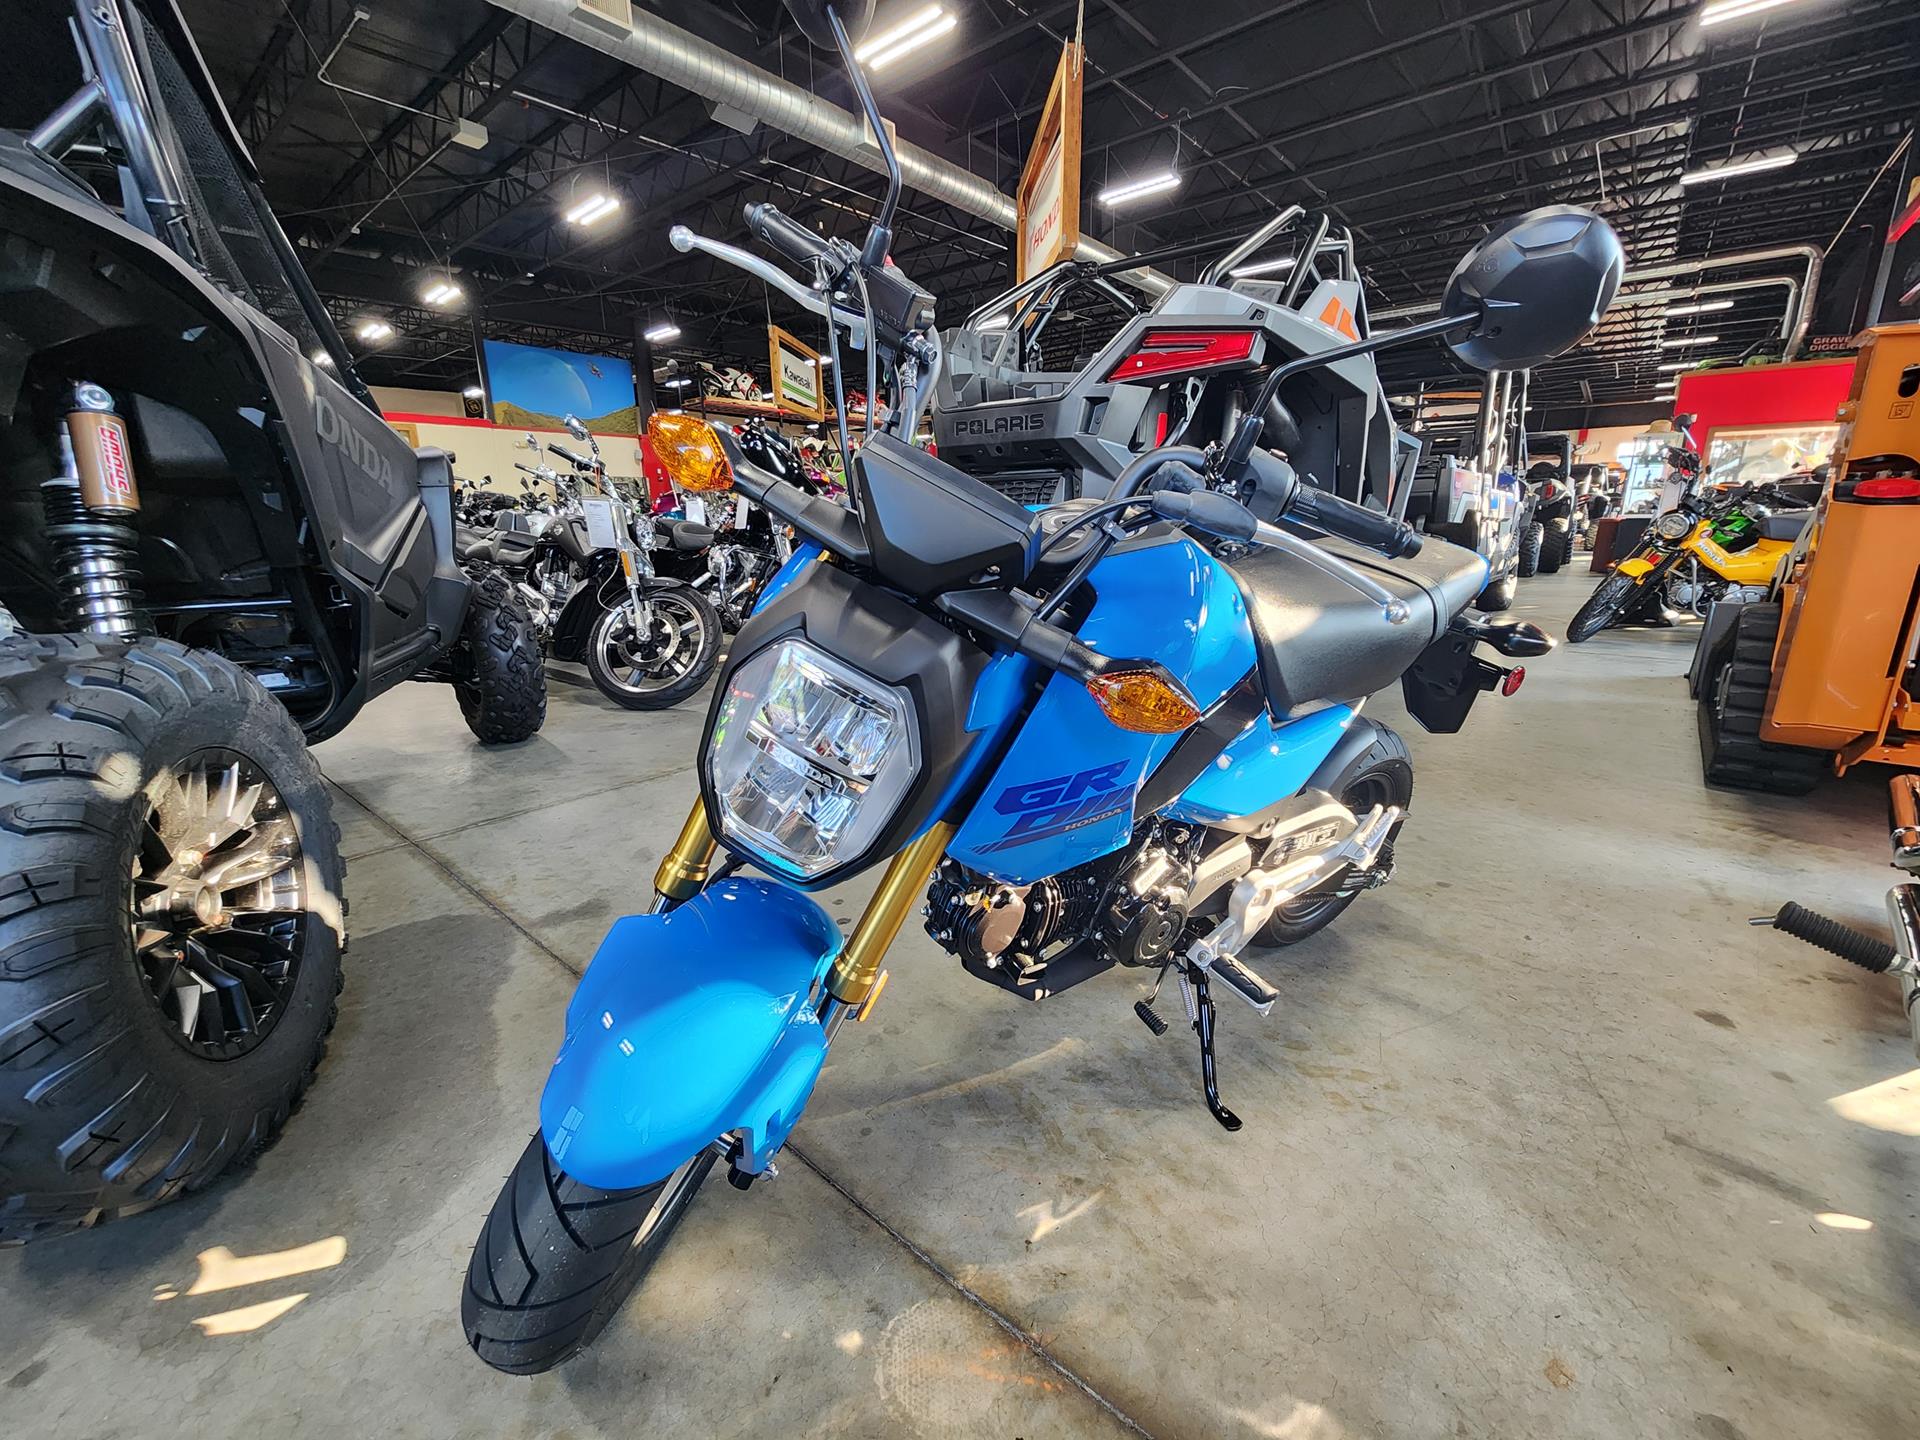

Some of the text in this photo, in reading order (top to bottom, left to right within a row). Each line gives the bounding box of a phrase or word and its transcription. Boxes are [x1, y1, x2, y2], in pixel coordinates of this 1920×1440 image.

[1032, 196, 1060, 249] HOND
[783, 363, 813, 392] Kawasaki
[954, 413, 1045, 437] POLARIS
[98, 426, 130, 494] SHOWA
[315, 395, 397, 498] ONDA
[1696, 541, 1729, 569] HONDA
[1063, 807, 1123, 832] HONDA
